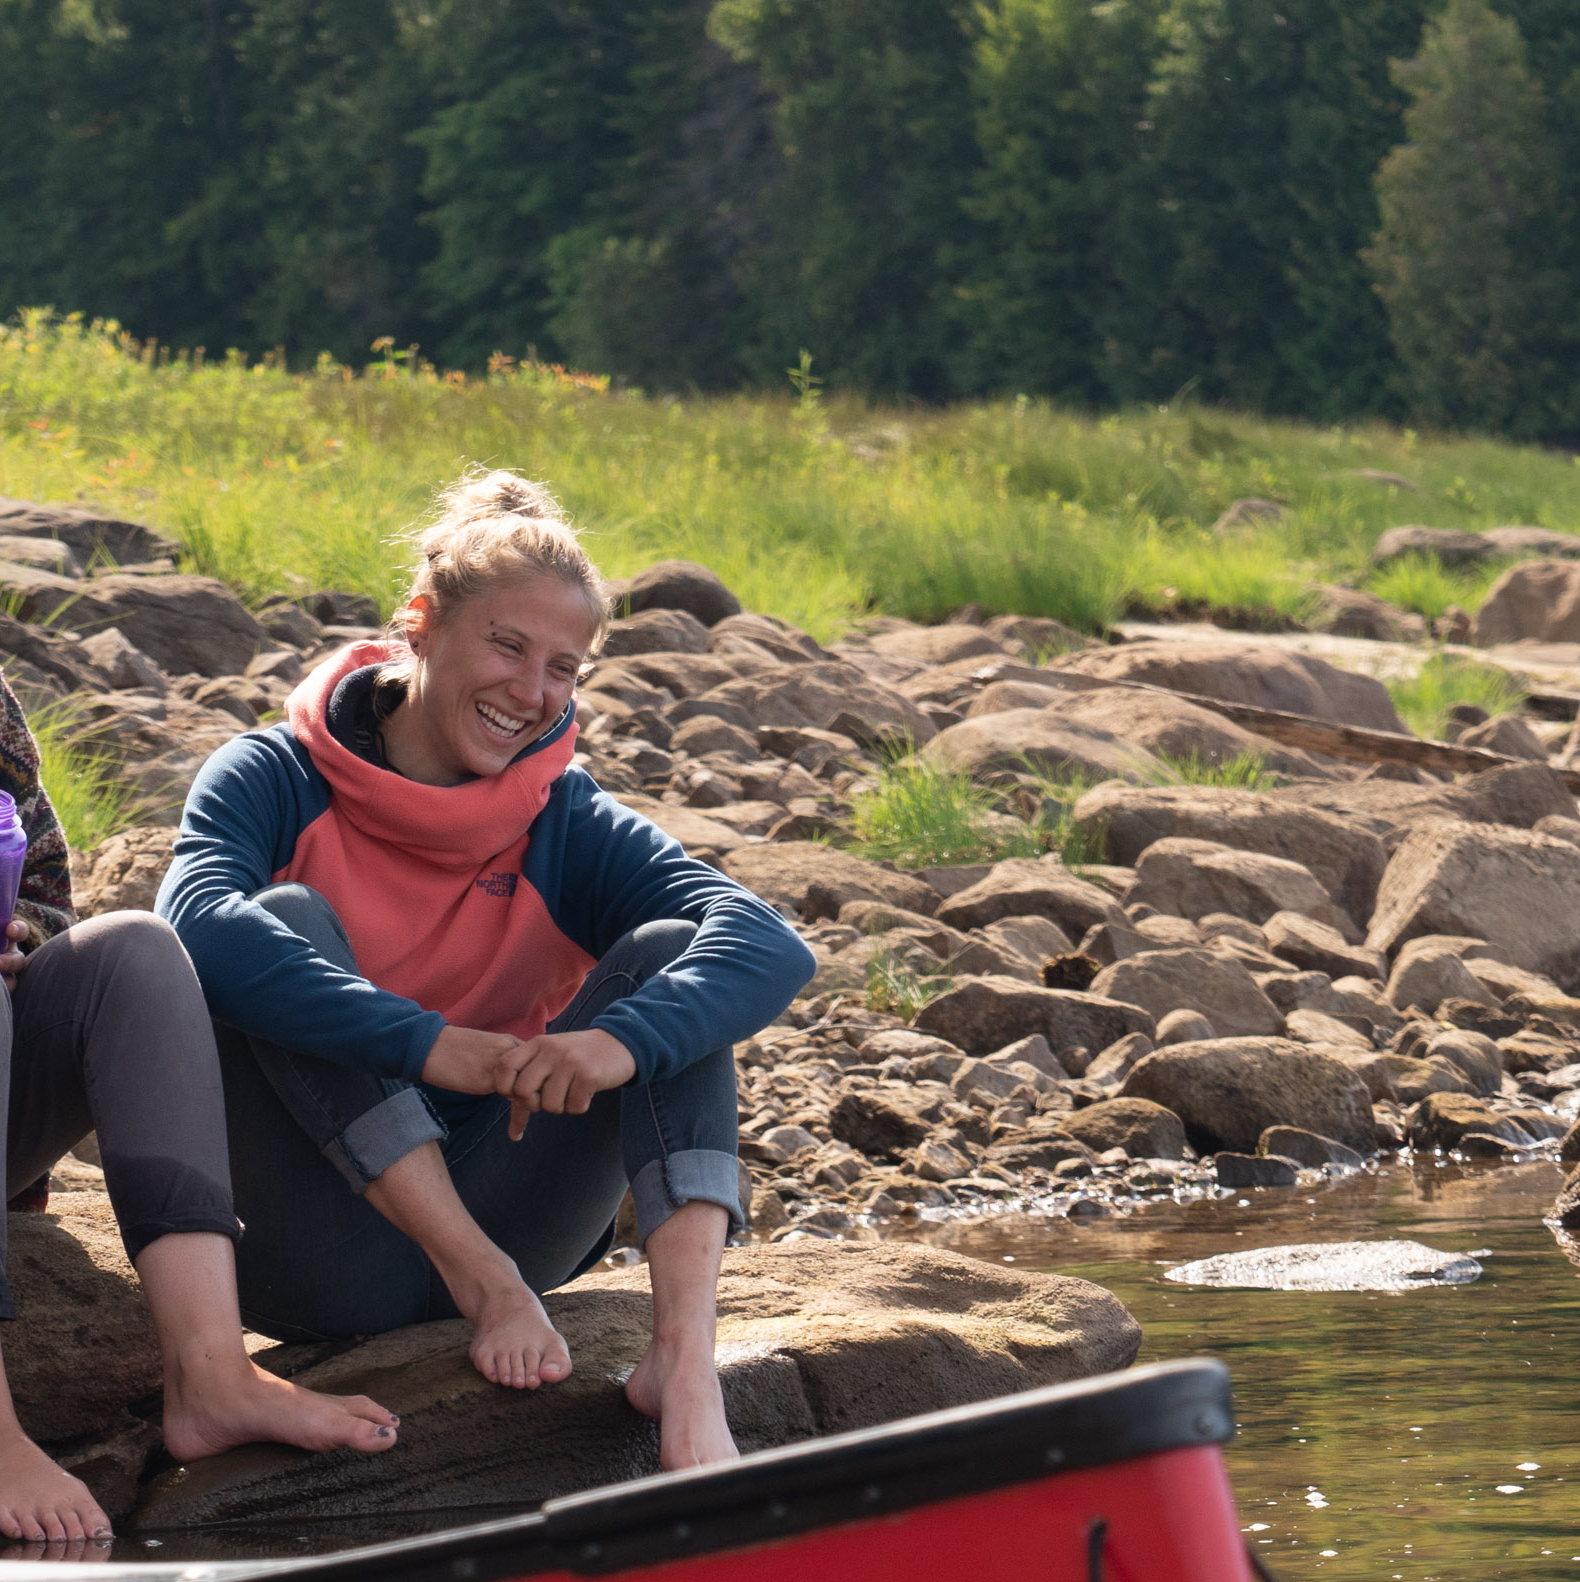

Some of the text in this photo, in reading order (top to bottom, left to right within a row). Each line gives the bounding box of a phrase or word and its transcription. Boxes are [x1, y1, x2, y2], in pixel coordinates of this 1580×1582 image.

[491, 873, 509, 881] THE
[476, 880, 510, 888] NORTH
[486, 888, 510, 897] FACE
